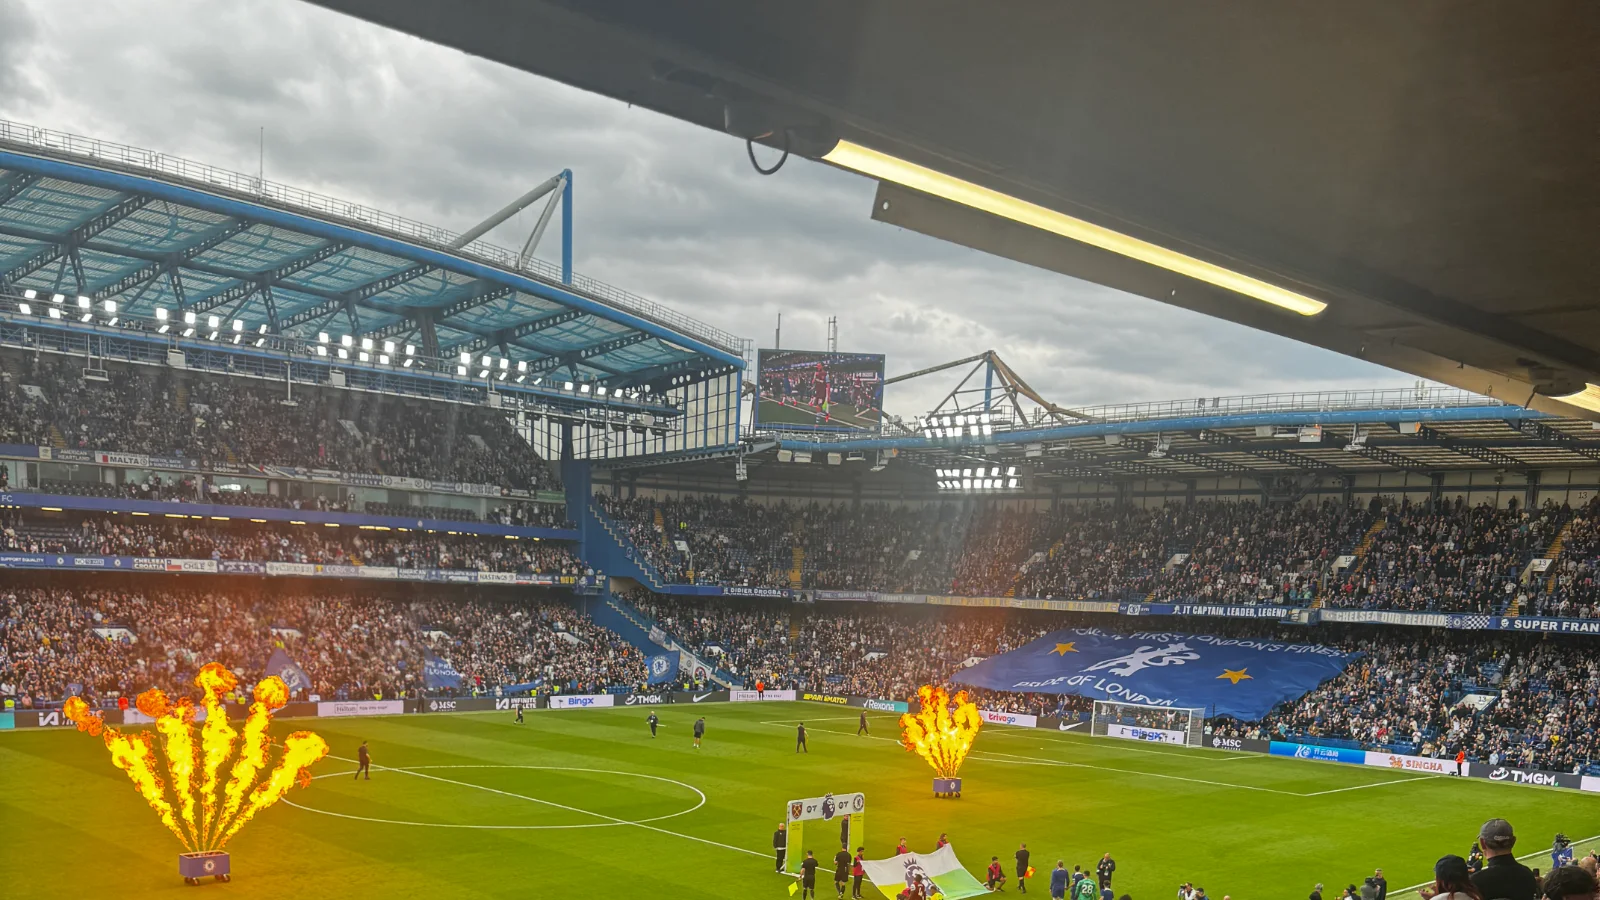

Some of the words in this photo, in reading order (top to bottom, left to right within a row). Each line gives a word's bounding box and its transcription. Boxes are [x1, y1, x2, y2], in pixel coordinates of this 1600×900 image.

[109, 456, 139, 465] MALTA
[1182, 606, 1191, 614] JT
[1258, 608, 1287, 617] LEGEND
[1336, 611, 1377, 622] CHELSEA
[1380, 612, 1400, 623] OUR
[1404, 614, 1445, 626] RELIGIO
[1514, 620, 1557, 631] SUPER
[1067, 675, 1096, 686] OF
[438, 701, 456, 709] MSC
[637, 695, 661, 704] TMGM
[868, 699, 895, 711] Rexona
[988, 713, 1015, 724] trivago
[1222, 737, 1241, 748] MSC
[1406, 760, 1443, 772] SINGHA
[1511, 769, 1555, 786] TMGM
[1082, 884, 1094, 895] 28
